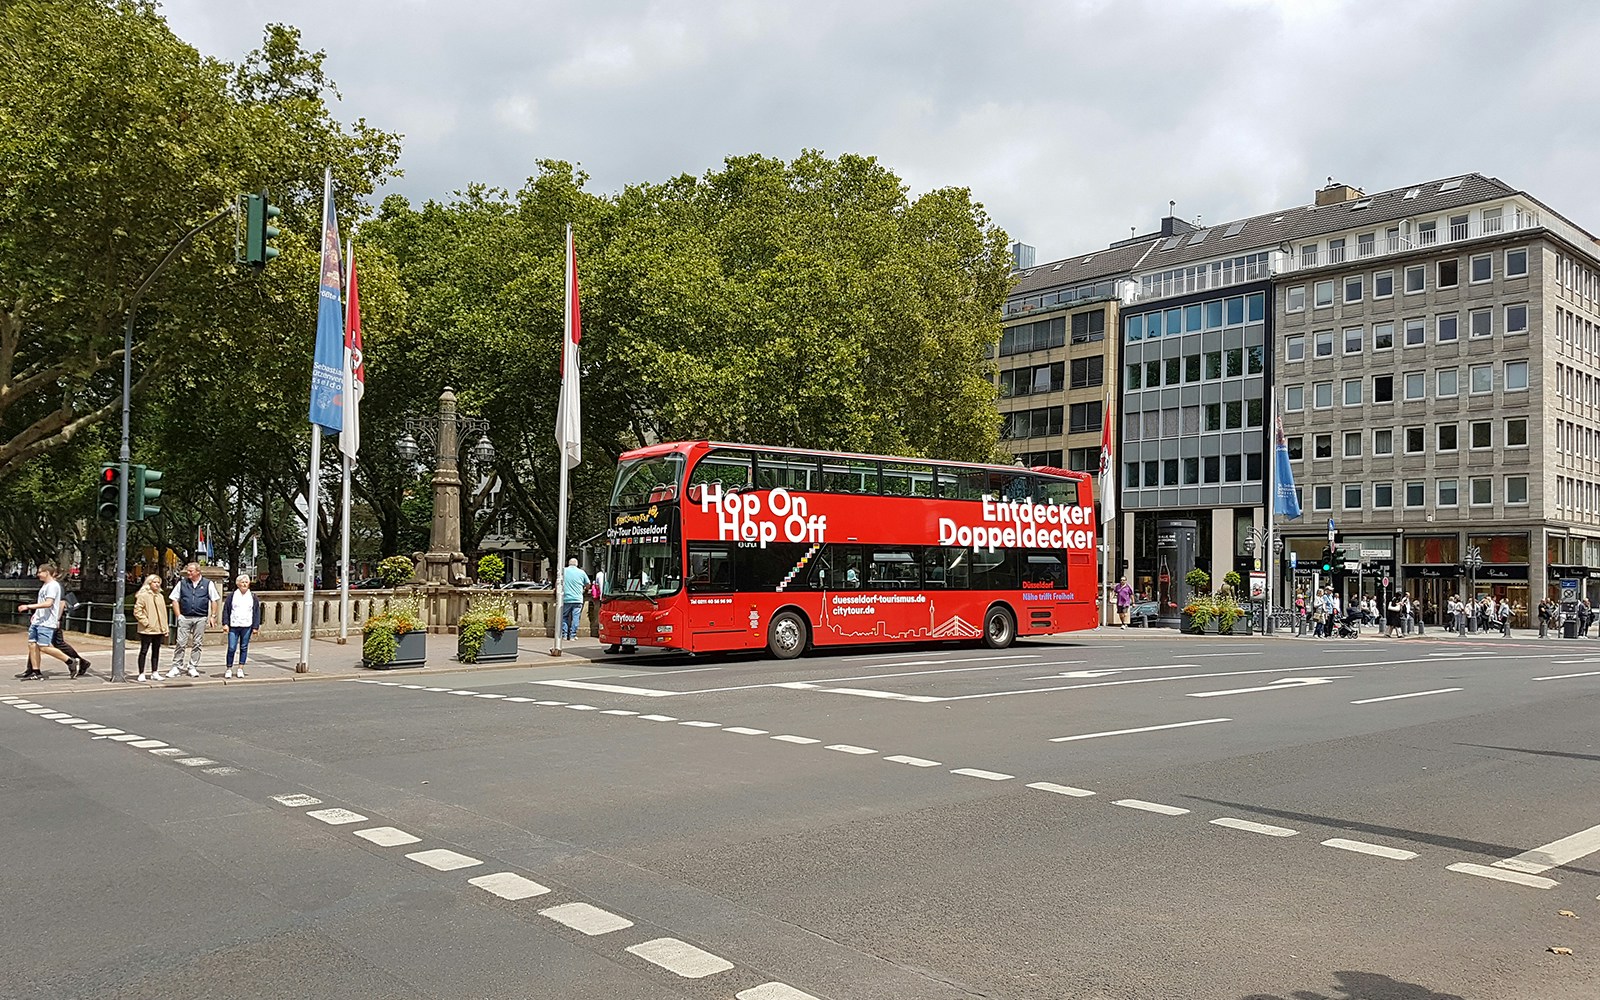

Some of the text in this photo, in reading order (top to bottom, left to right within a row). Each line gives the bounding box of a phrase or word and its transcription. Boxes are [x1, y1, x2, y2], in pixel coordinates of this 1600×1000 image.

[701, 483, 807, 522] Hop On
[981, 494, 1092, 526] Entdecker
[606, 524, 668, 538] City-Tour Düsseldorf
[718, 511, 826, 549] Hop Off
[938, 517, 1093, 553] Doppeldecker
[1022, 581, 1054, 589] Düsseldorf
[832, 594, 926, 604] duesseldorf-tourismus.de
[1053, 592, 1074, 600] Freiheit
[832, 606, 875, 616] citytour.de
[612, 613, 644, 623] citytour.de
